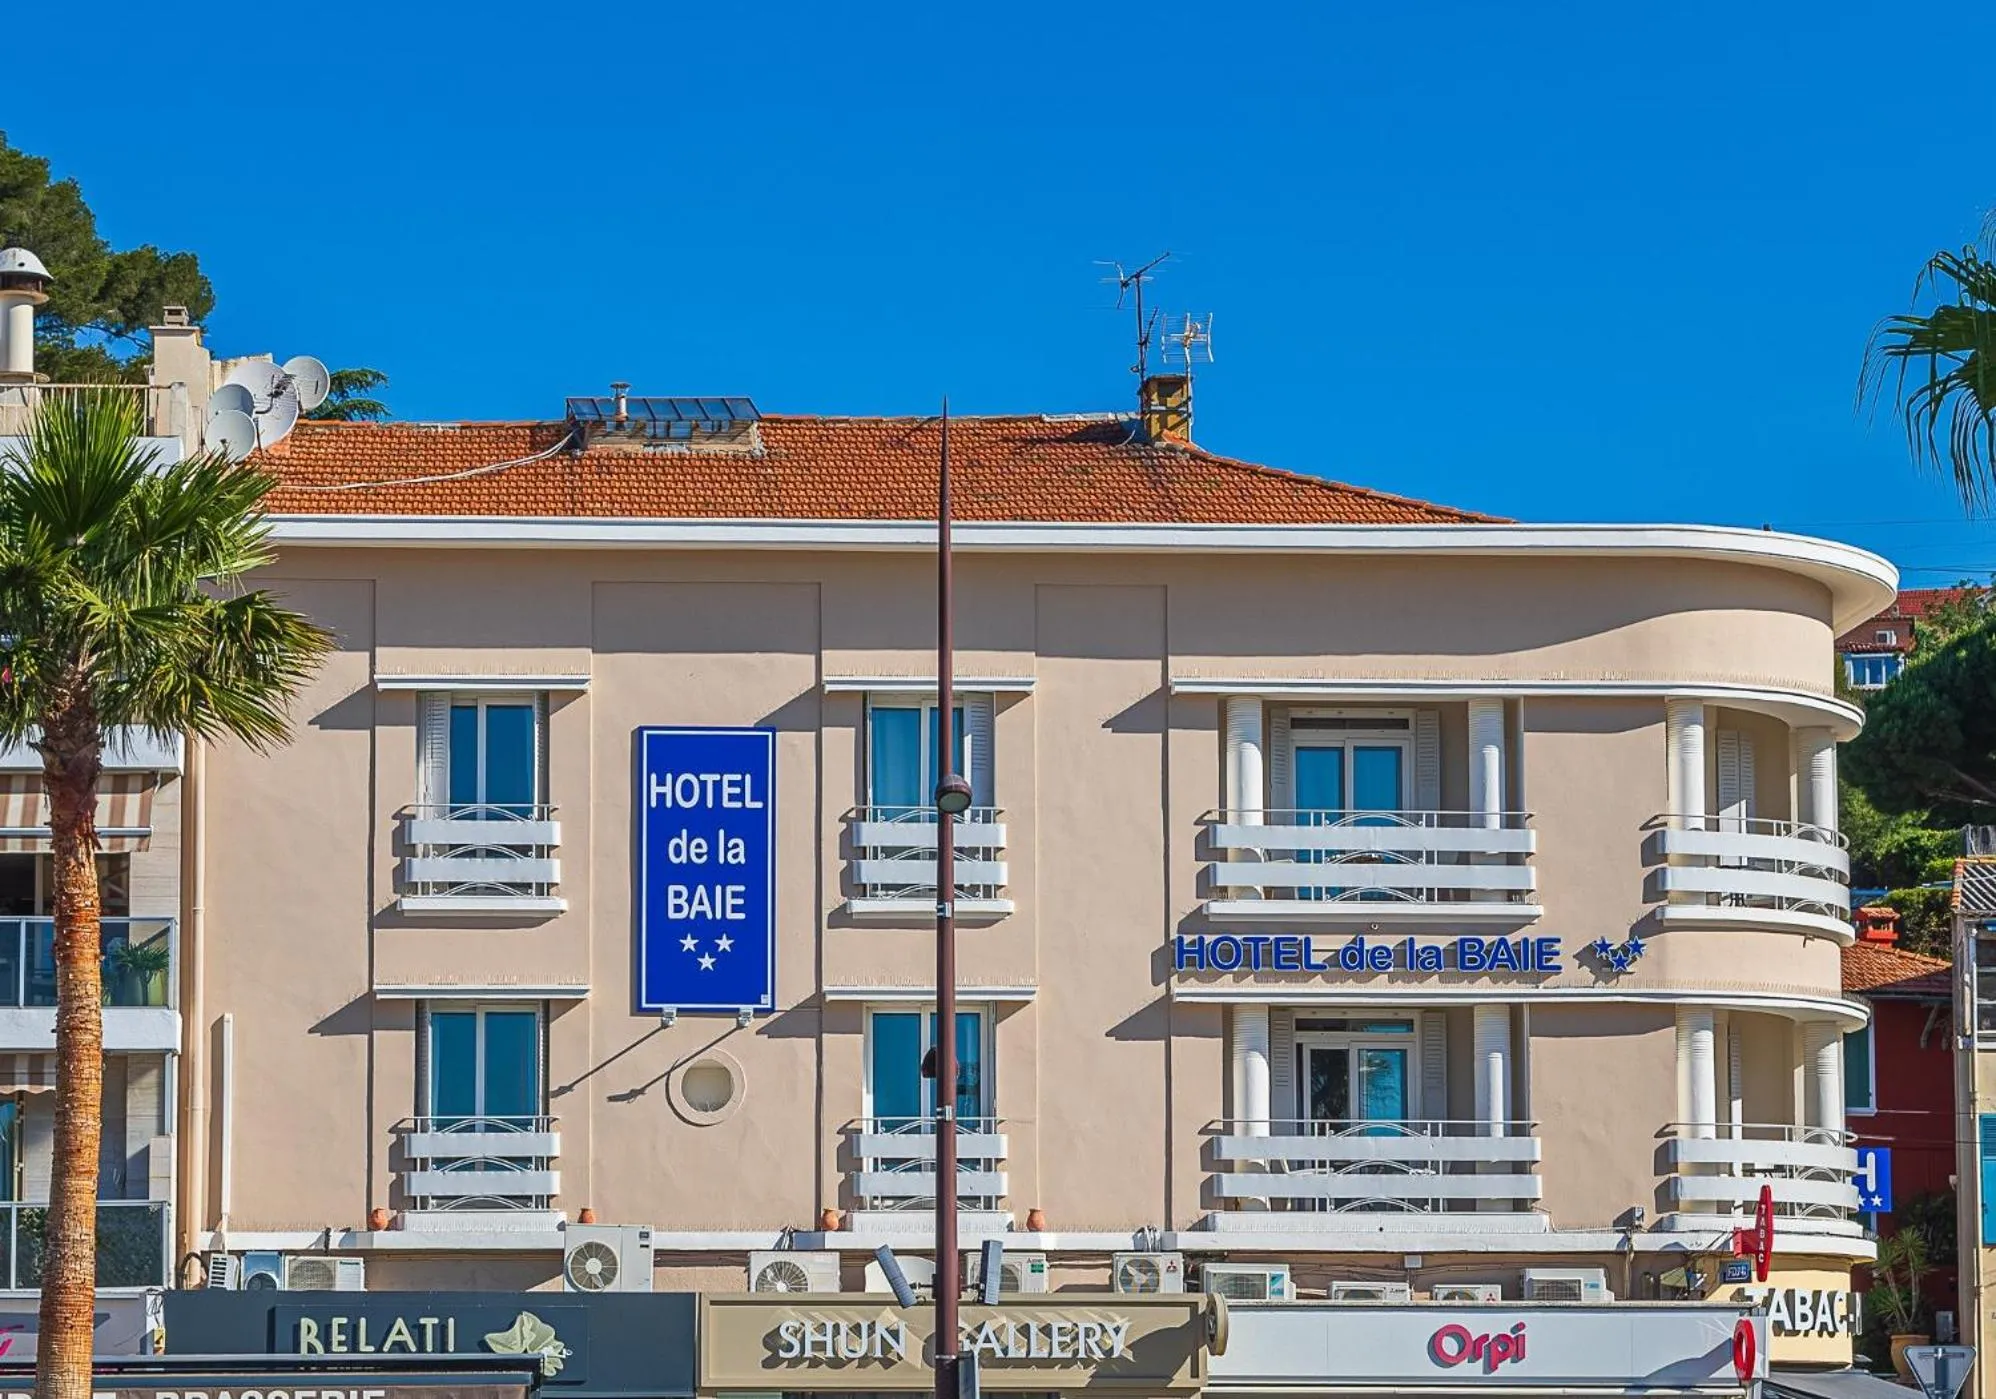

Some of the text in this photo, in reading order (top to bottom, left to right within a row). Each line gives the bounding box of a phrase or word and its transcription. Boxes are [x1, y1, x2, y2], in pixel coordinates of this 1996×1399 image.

[650, 772, 764, 809] HOTEL
[668, 828, 746, 864] de la
[667, 884, 746, 920] BAIE
[1175, 935, 1562, 973] HOTEL de la BAIE
[300, 1317, 455, 1355] RELATI
[779, 1319, 907, 1360] SHUN
[1431, 1322, 1526, 1373] Orpi
